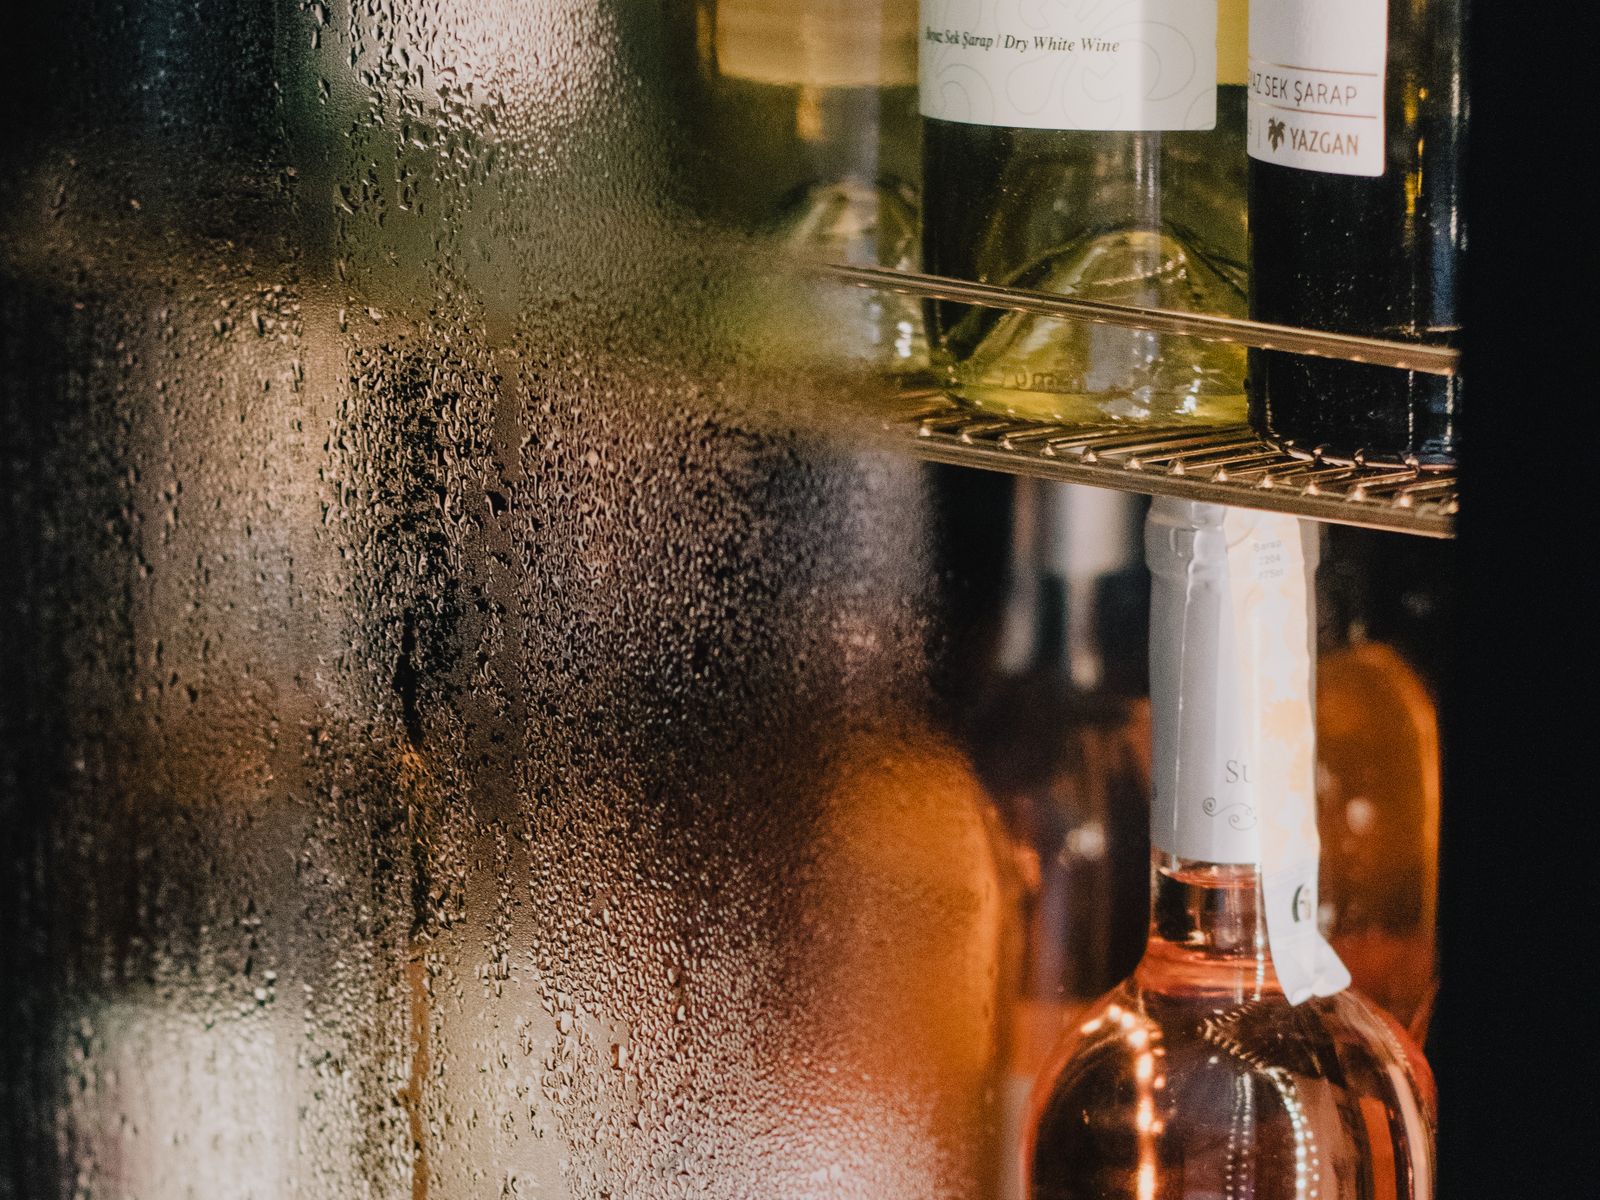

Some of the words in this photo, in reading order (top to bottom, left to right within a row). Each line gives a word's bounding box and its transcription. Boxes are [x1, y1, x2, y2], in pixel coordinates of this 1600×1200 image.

[1004, 34, 1030, 54] Dry
[1033, 35, 1076, 53] White
[1080, 37, 1121, 54] Wine
[1264, 75, 1288, 100] SEK
[1293, 80, 1358, 108] ŞARAP
[1289, 127, 1359, 157] YAZGAN
